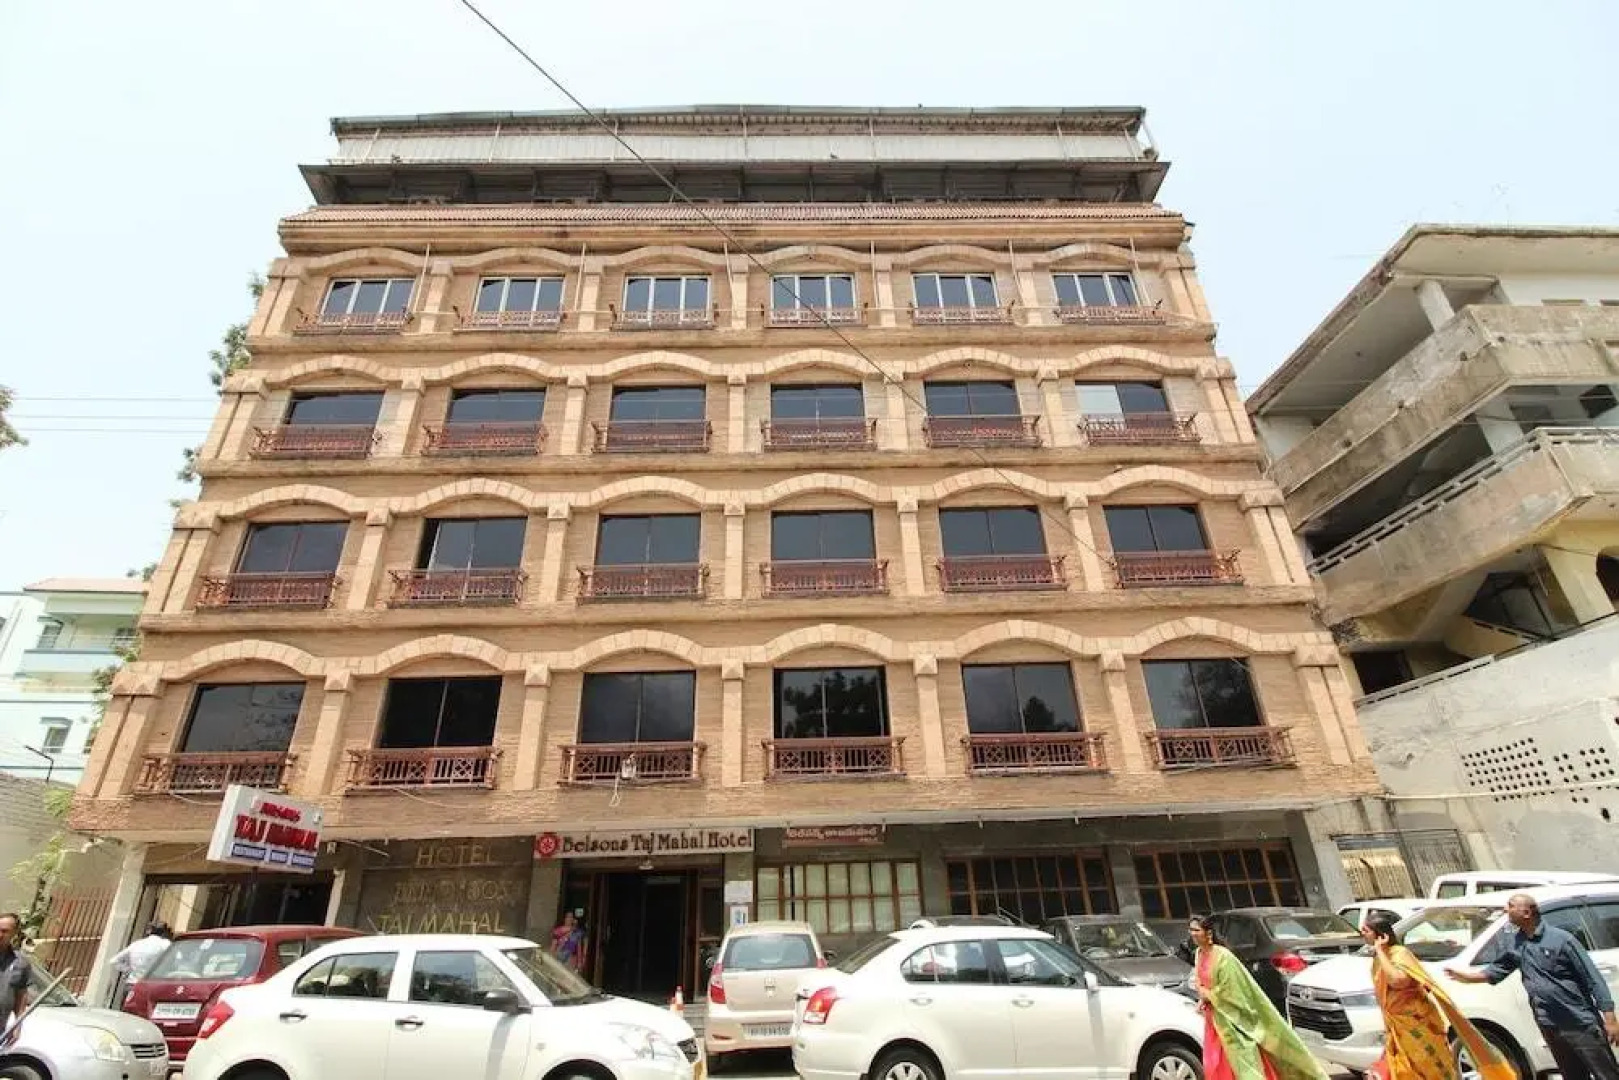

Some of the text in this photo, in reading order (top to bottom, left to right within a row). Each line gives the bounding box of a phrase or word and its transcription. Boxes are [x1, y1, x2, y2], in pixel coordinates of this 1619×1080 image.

[631, 832, 655, 854] Taj
[658, 831, 704, 851] Mahal
[708, 829, 753, 848] Hotel
[416, 844, 493, 865] HOTEL
[418, 912, 505, 934] MAHAL
